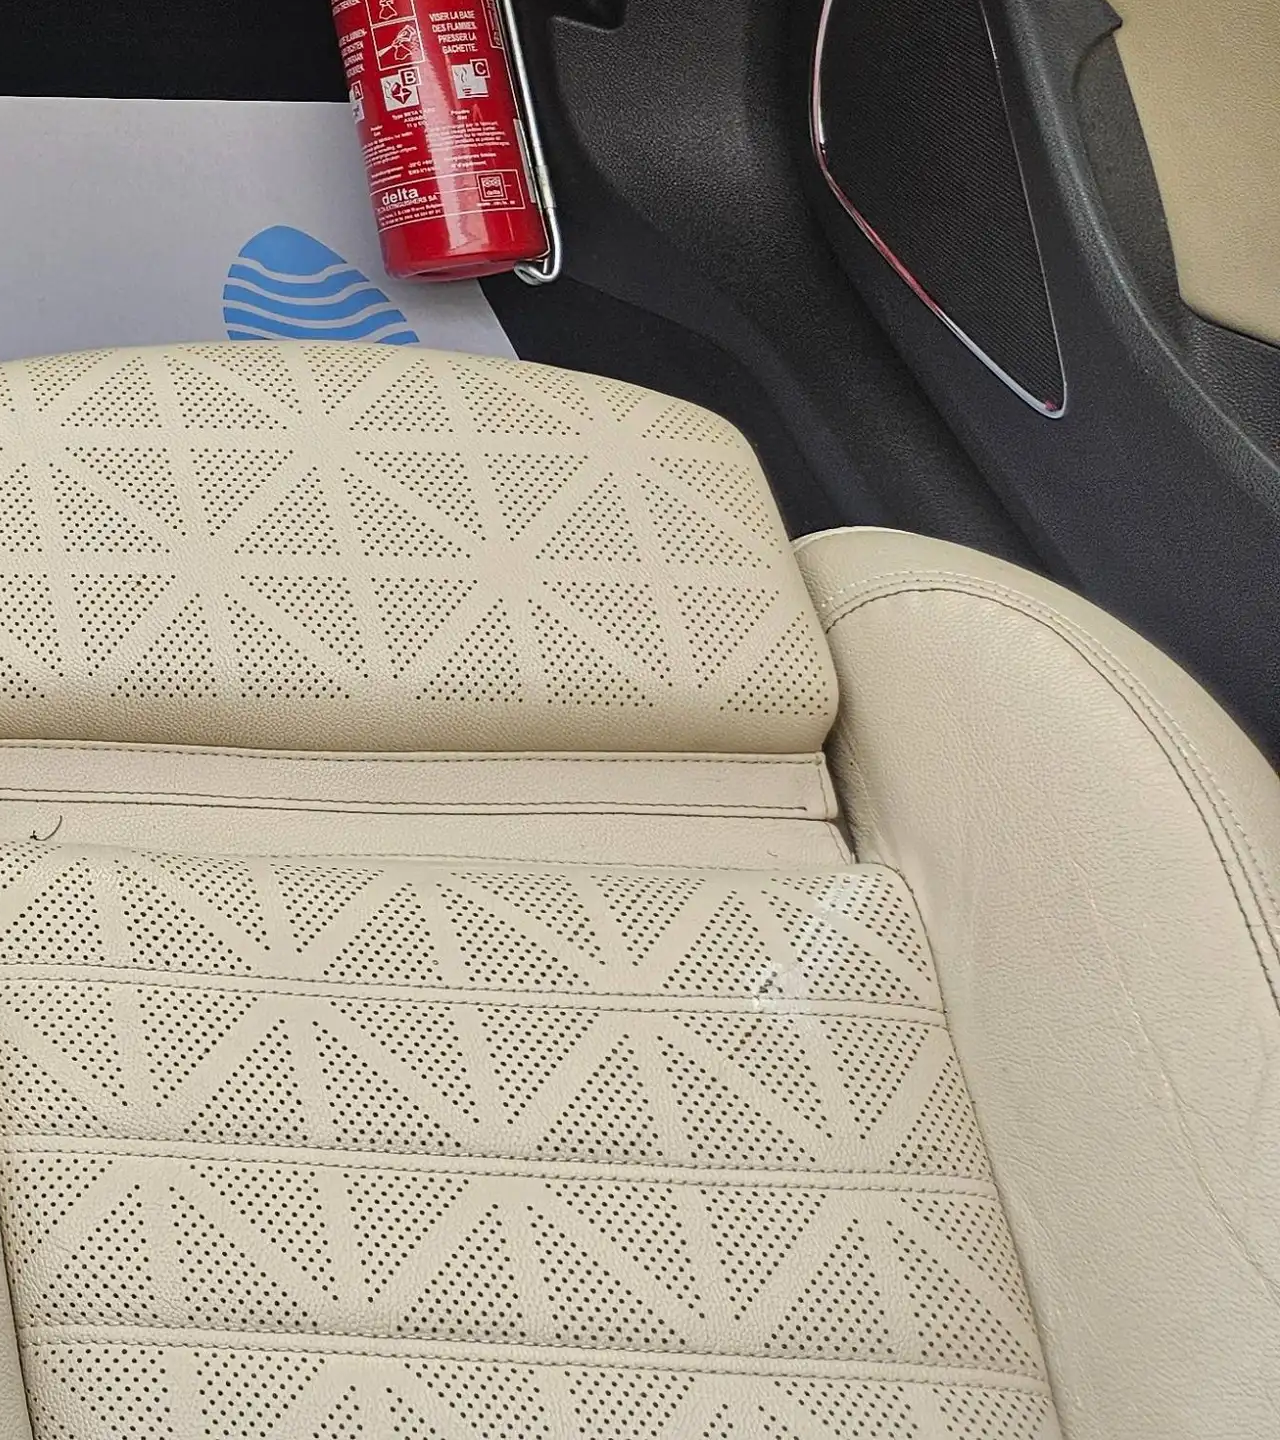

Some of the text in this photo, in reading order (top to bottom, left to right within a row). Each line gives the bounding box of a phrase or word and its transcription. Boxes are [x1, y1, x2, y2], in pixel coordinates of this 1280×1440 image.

[429, 10, 476, 22] VISER LA BASE
[432, 24, 446, 32] DES
[438, 33, 477, 44] PRESSER LA
[474, 62, 486, 76] C
[404, 71, 417, 85] B
[381, 186, 419, 206] delta
